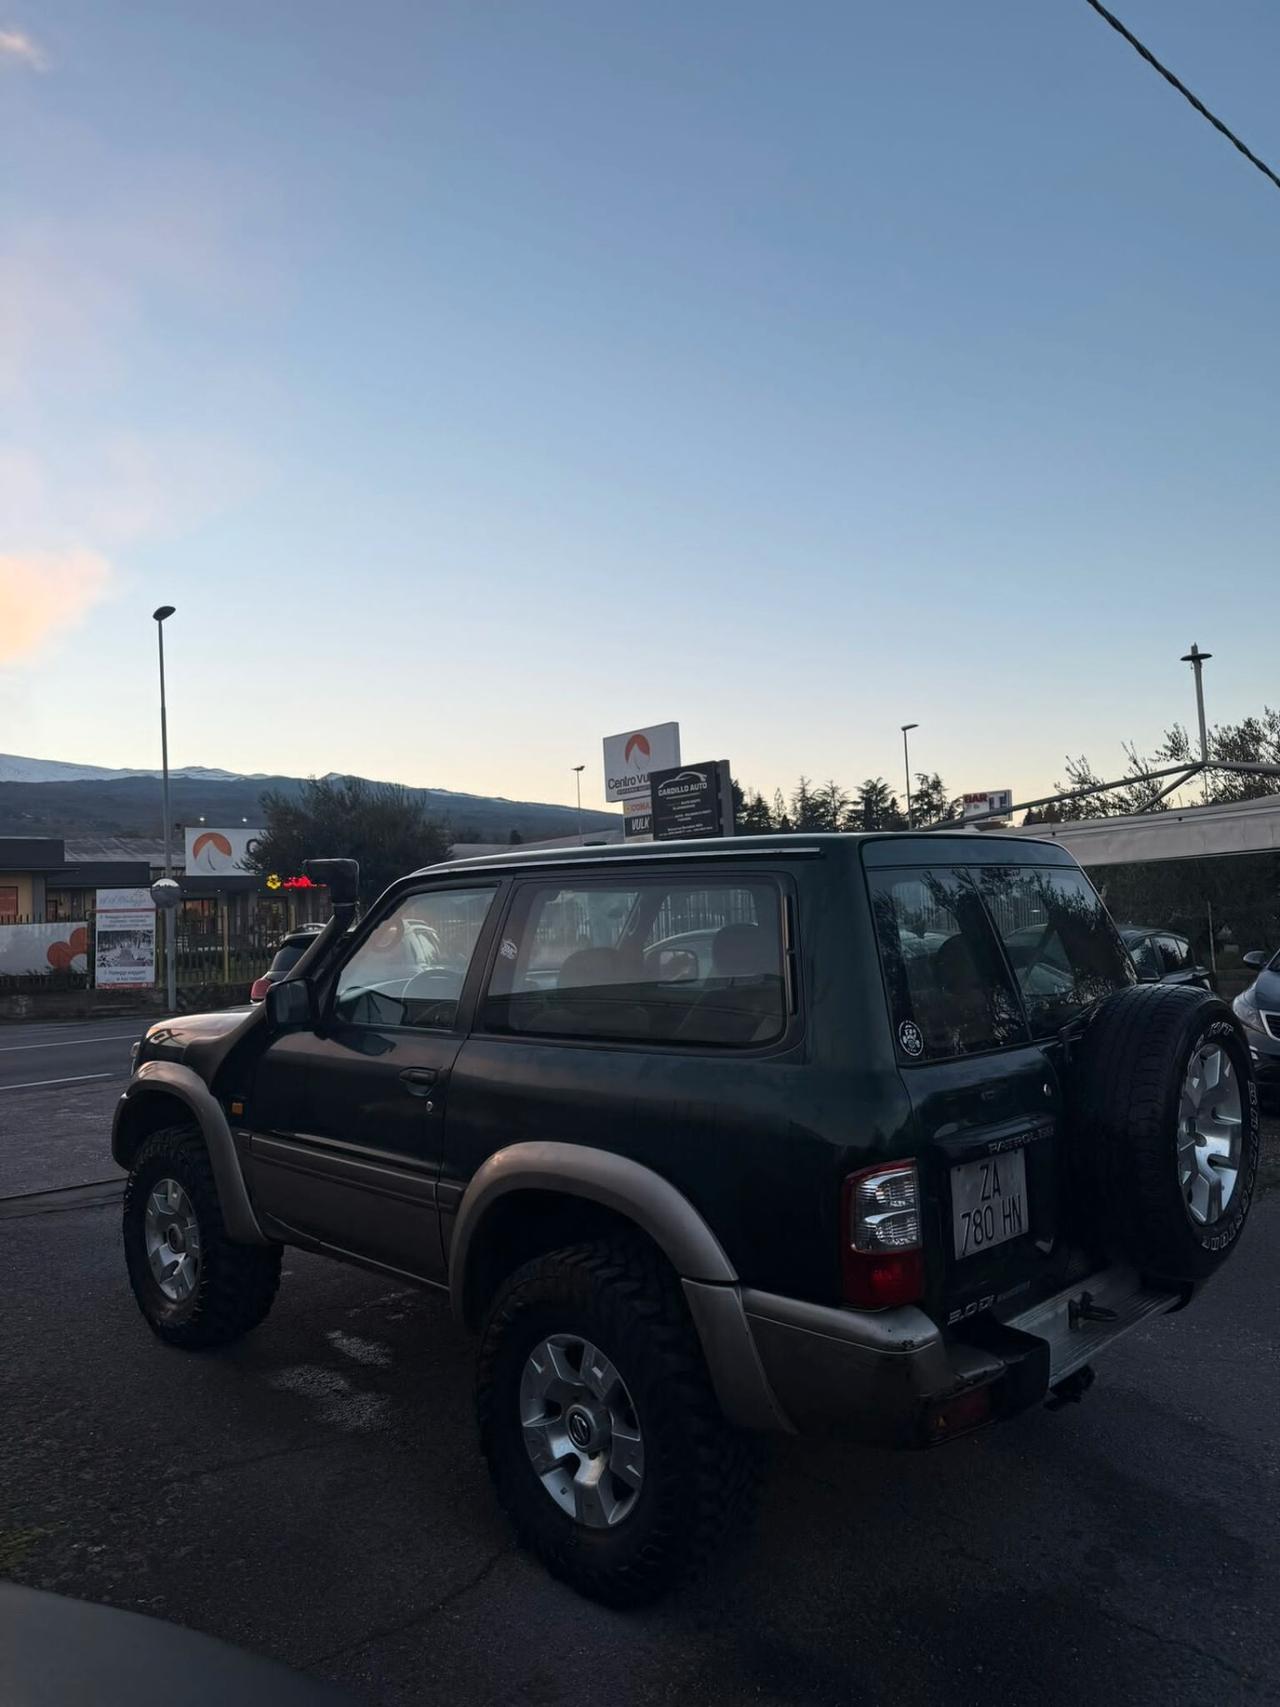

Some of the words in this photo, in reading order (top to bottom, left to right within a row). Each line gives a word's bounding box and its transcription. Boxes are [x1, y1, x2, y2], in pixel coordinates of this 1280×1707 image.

[608, 775, 636, 789] Centro
[690, 782, 708, 792] AUTO
[963, 793, 988, 803] BAR
[980, 1160, 1001, 1201] ZA
[961, 1205, 994, 1256] 780
[1001, 1195, 1022, 1235] HN
